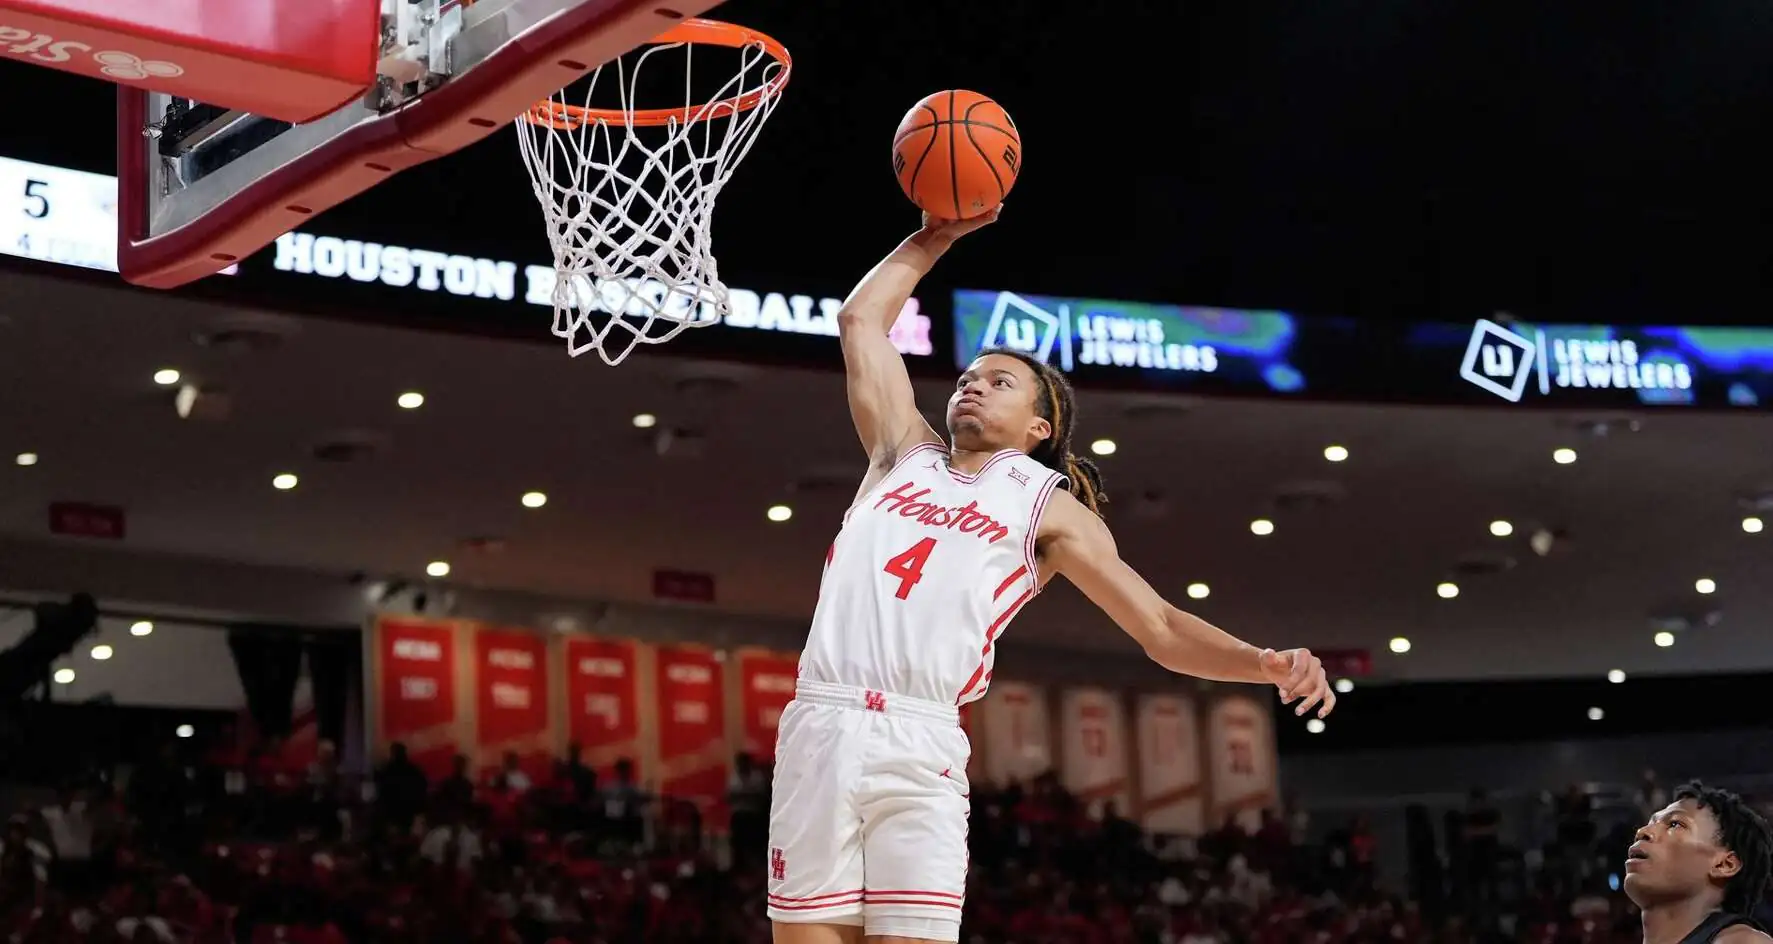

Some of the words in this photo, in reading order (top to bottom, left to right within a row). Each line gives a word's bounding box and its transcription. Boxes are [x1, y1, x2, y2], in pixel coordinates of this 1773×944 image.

[24, 179, 49, 218] 5
[274, 231, 517, 301] HOUSTON
[1078, 314, 1165, 344] LEWIS
[1078, 340, 1218, 373] JEWELERS
[1553, 338, 1639, 366] LEWIS
[1556, 361, 1692, 389] JEWELERS
[873, 481, 1009, 544] Houston
[883, 536, 937, 601] 4
